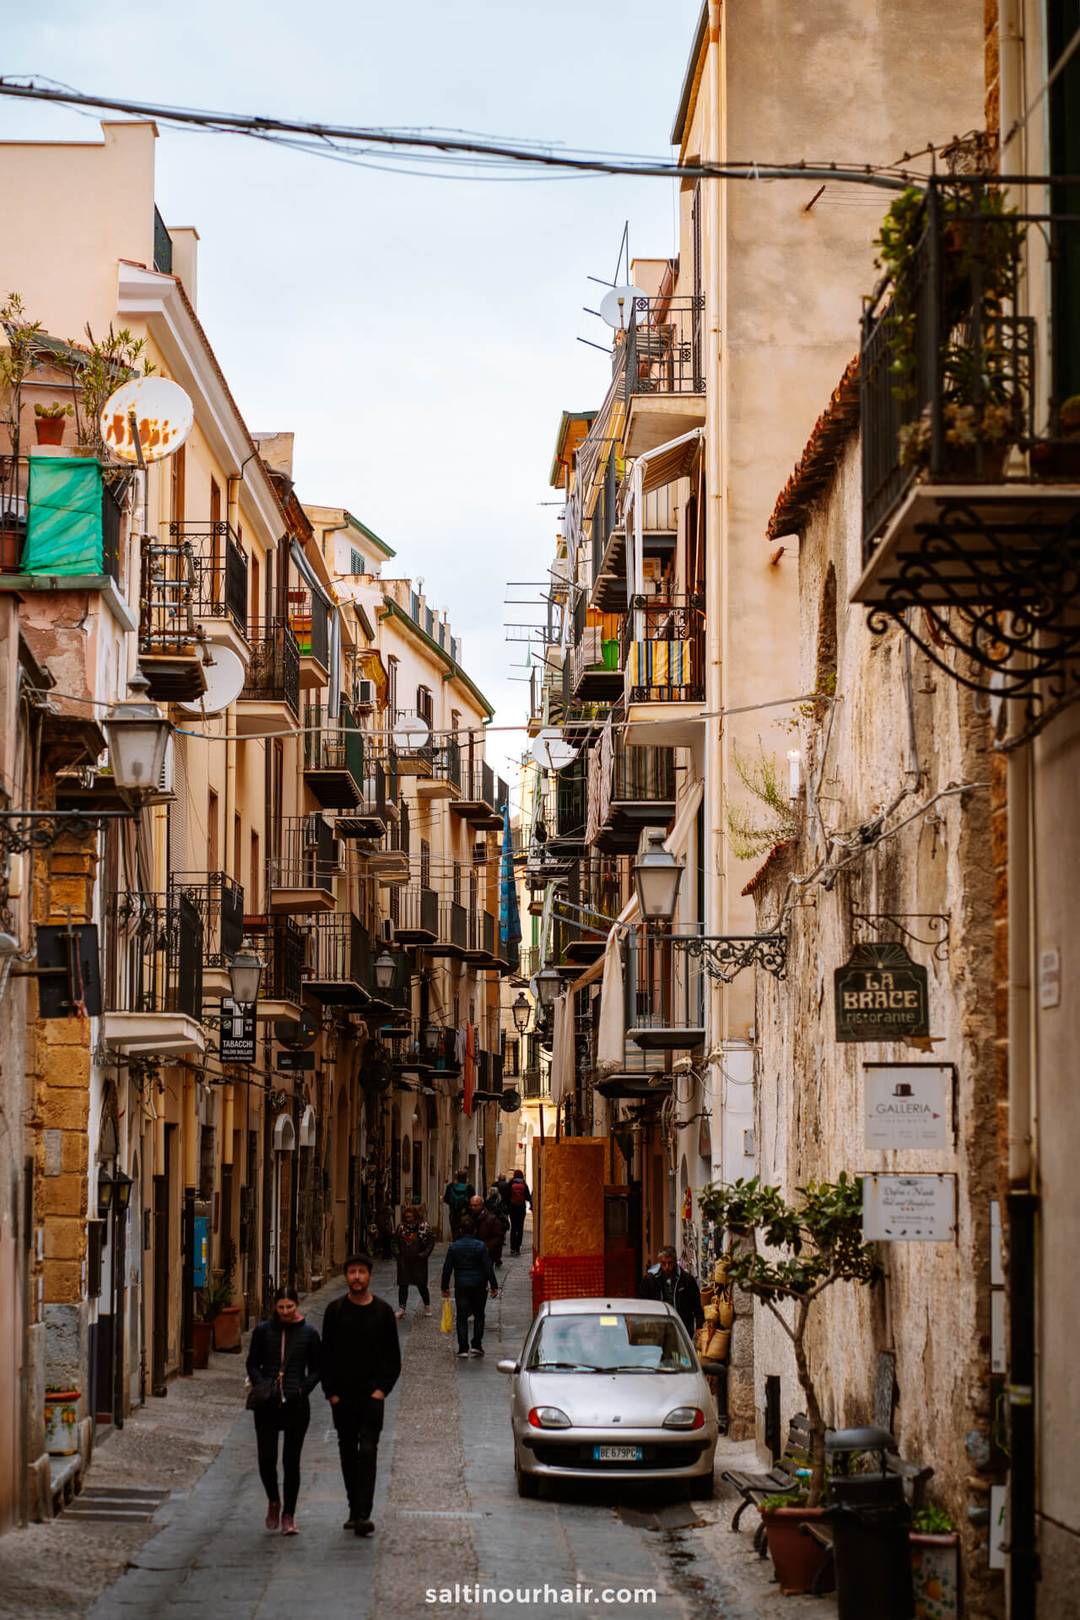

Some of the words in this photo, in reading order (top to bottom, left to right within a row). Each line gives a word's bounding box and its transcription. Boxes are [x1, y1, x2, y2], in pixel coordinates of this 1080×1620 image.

[865, 972, 895, 990] LA
[843, 990, 918, 1009] BRACE
[222, 1039, 253, 1048] TABACCHI
[876, 1103, 931, 1114] GALLERIA
